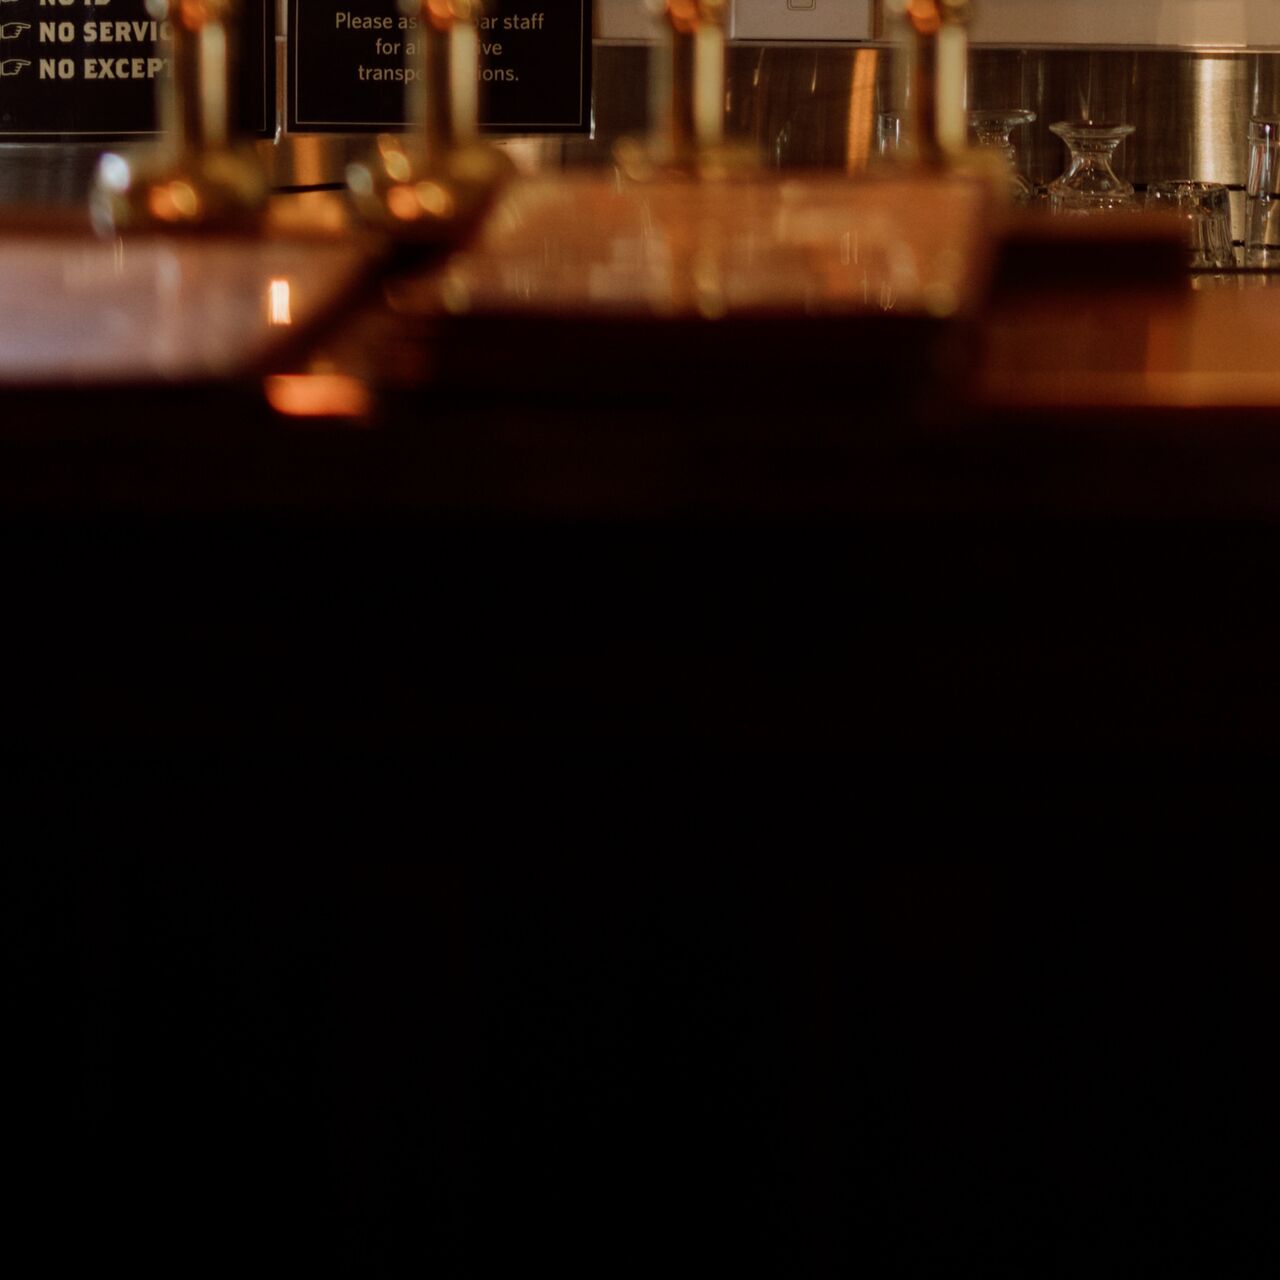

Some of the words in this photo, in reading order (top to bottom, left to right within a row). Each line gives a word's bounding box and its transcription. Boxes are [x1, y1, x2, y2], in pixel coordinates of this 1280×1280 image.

[335, 11, 393, 30] Please
[398, 15, 418, 30] as
[503, 12, 545, 30] staff
[39, 21, 75, 43] NO
[375, 38, 401, 55] for
[39, 58, 75, 80] NO
